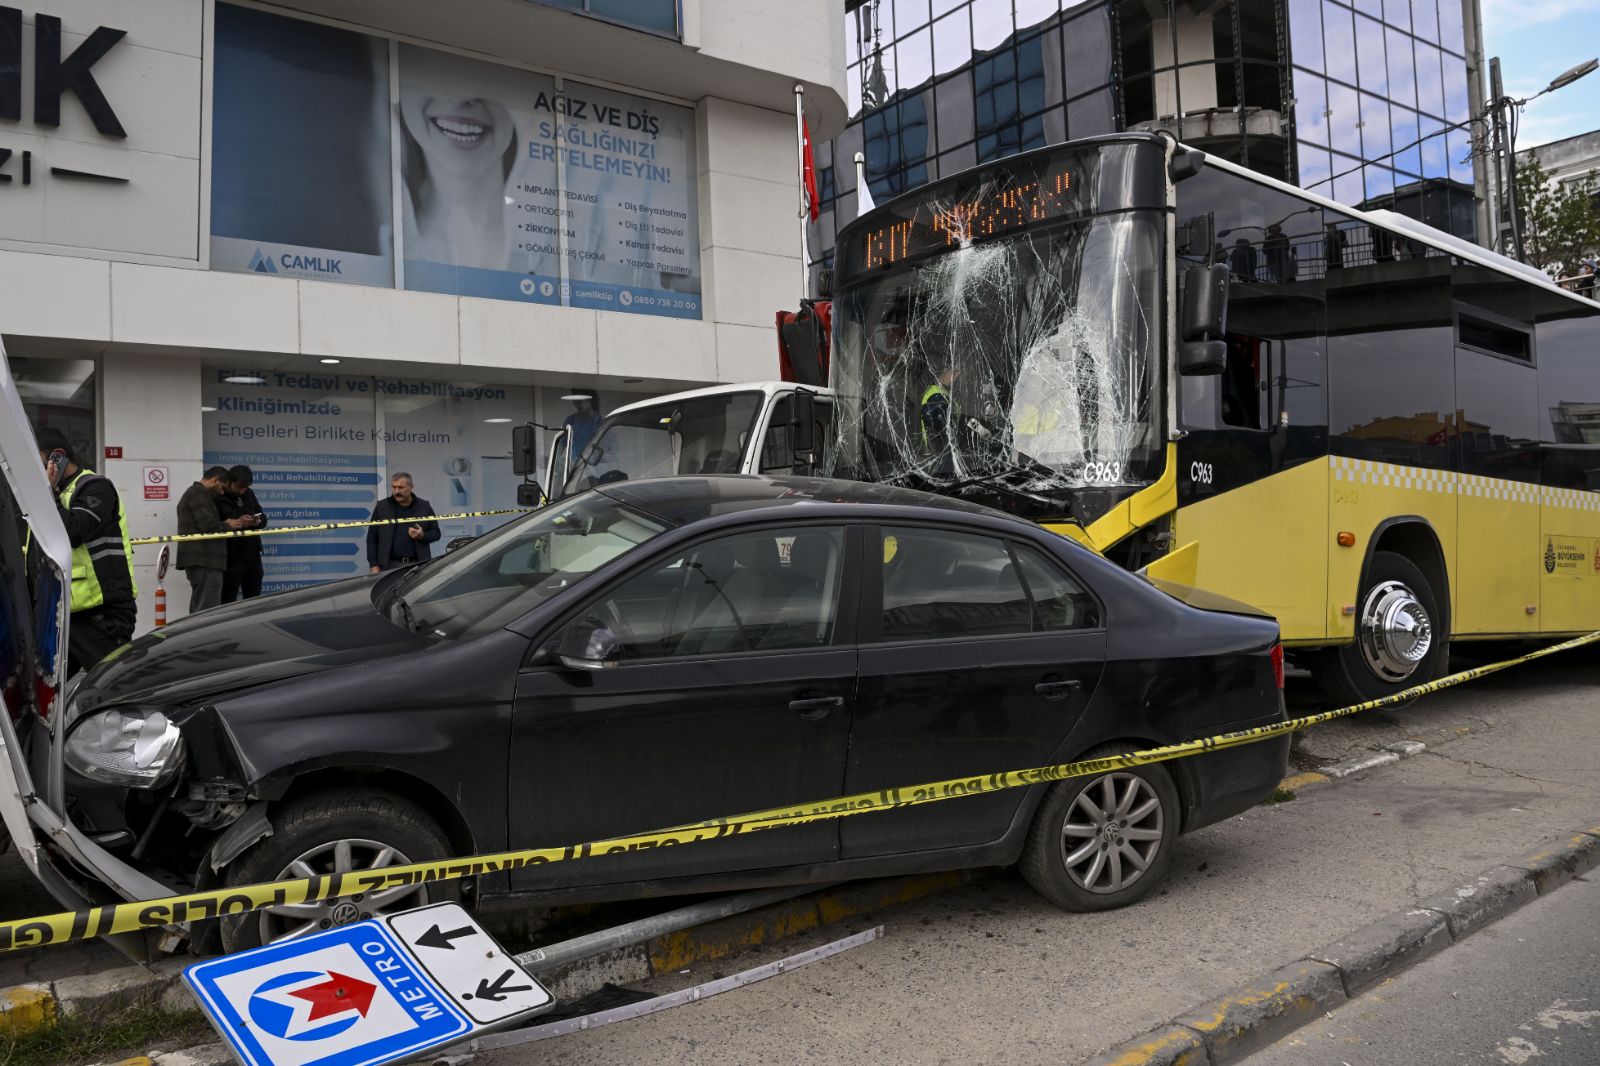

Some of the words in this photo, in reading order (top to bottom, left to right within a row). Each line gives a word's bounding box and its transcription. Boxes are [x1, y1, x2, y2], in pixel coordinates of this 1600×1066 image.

[534, 90, 587, 120] AĞIZ
[592, 104, 621, 127] VE
[627, 110, 660, 140] DİŞ
[539, 121, 656, 160] SAĞLIĞINIZI
[528, 141, 672, 184] ERTELEMEYİN!
[624, 201, 638, 214] Diş
[639, 204, 687, 220] Beyazlatma
[625, 220, 638, 232] Diş
[650, 225, 684, 237] Tedavisi
[625, 239, 650, 250] Kanal
[651, 243, 685, 255] Tedavisi
[626, 258, 655, 270] Yaprak
[685, 301, 697, 310] 00
[274, 373, 340, 391] Tedavi
[346, 380, 368, 392] ve
[374, 379, 505, 400] Rehabilitasyon
[218, 396, 341, 415] Kliniğimizde
[218, 422, 298, 439] Engelleri
[305, 426, 365, 441] Birlikte
[371, 429, 450, 444] Kaldıralım
[261, 473, 284, 481] Palsi
[286, 474, 358, 483] Rehabilitasyonu
[1084, 461, 1120, 483] C963
[1191, 461, 1213, 484] C963
[362, 941, 445, 1021] METRO
